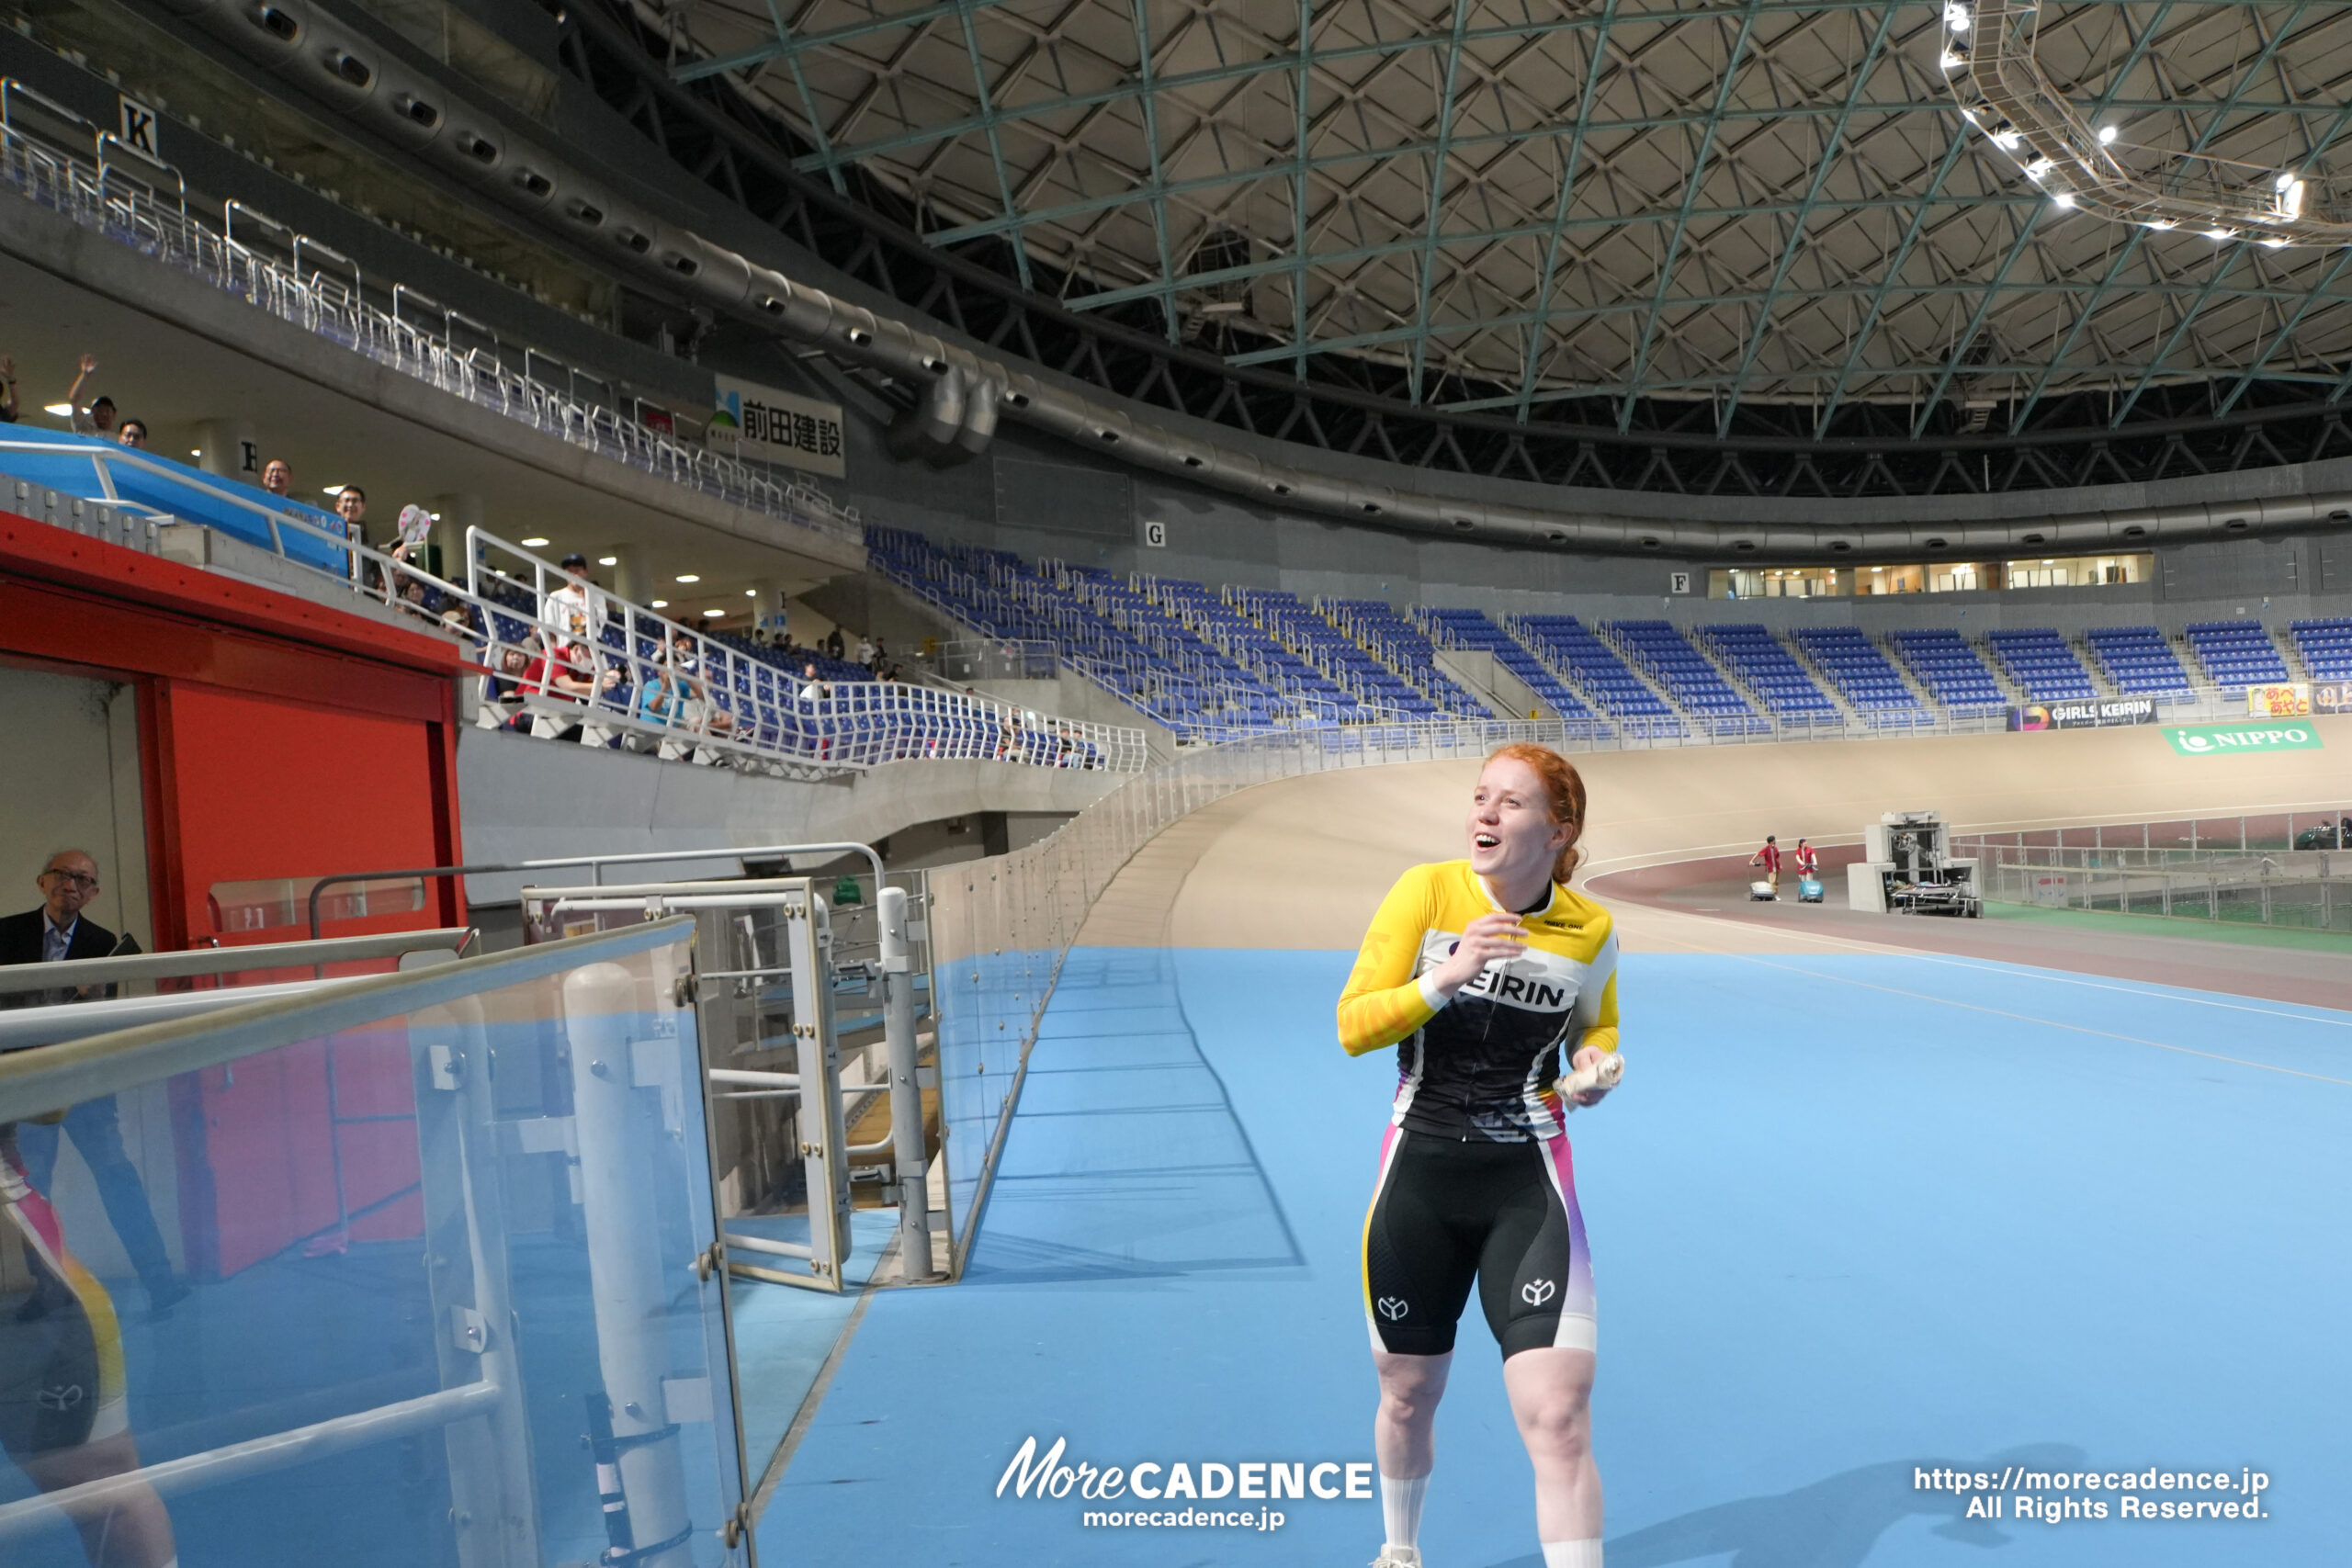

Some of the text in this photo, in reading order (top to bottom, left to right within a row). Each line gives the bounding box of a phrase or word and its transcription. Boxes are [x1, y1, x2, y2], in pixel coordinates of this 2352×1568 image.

[121, 102, 154, 156] K
[742, 399, 841, 458] 前田建設
[1148, 525, 1162, 544] G
[1674, 575, 1687, 591] F
[2052, 700, 2152, 721] GIRLS KEIRIN
[2212, 728, 2308, 748] NIPPO
[1466, 968, 1565, 1008] EIRIN
